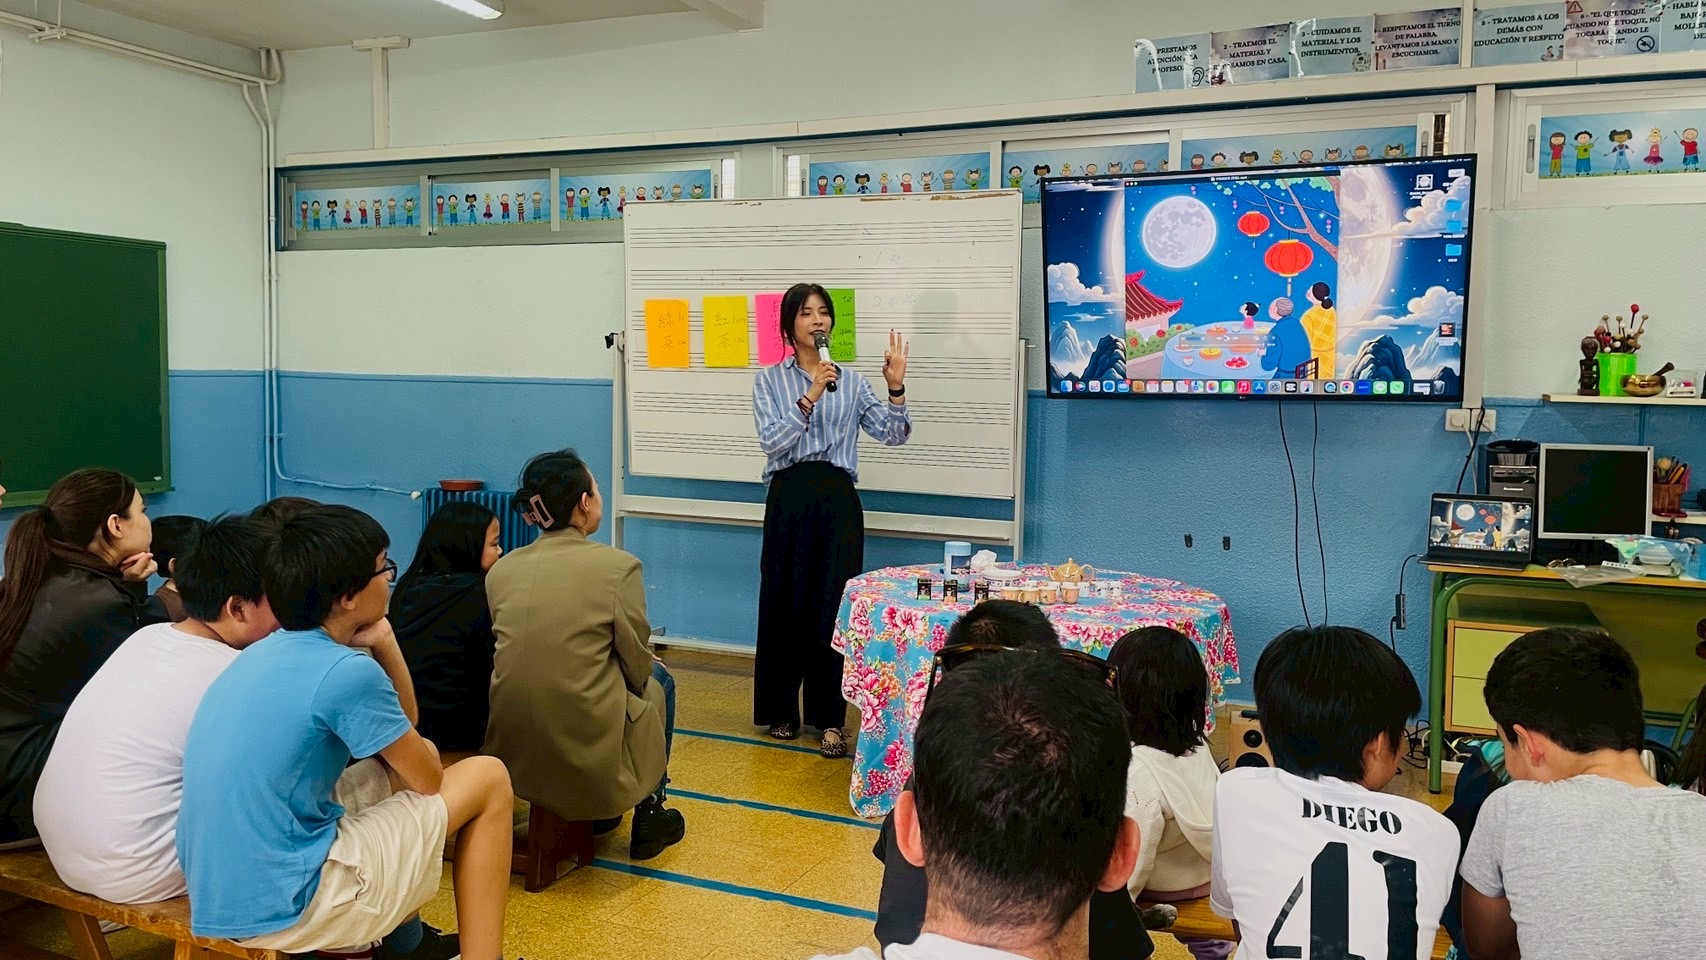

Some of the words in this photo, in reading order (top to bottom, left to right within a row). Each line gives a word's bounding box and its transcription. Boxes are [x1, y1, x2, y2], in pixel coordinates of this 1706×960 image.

[1619, 8, 1646, 16] TOQUE
[1492, 15, 1536, 24] TRATAMOS
[1382, 23, 1426, 32] RESPETAMOS
[1437, 20, 1461, 28] TURNO
[1497, 25, 1524, 34] DEMÁS
[1565, 21, 1597, 30] CUANDO
[1311, 27, 1351, 36] CUIDAMOS
[1233, 40, 1267, 48] TRAEMOS
[1302, 38, 1339, 47] MATERIAL
[1474, 35, 1520, 47] EDUCACIÓN
[1375, 42, 1420, 51] LEVANTAMOS
[1229, 50, 1265, 58] MATERIAL
[1302, 798, 1402, 835] DIEGO
[1266, 841, 1419, 960] 41
